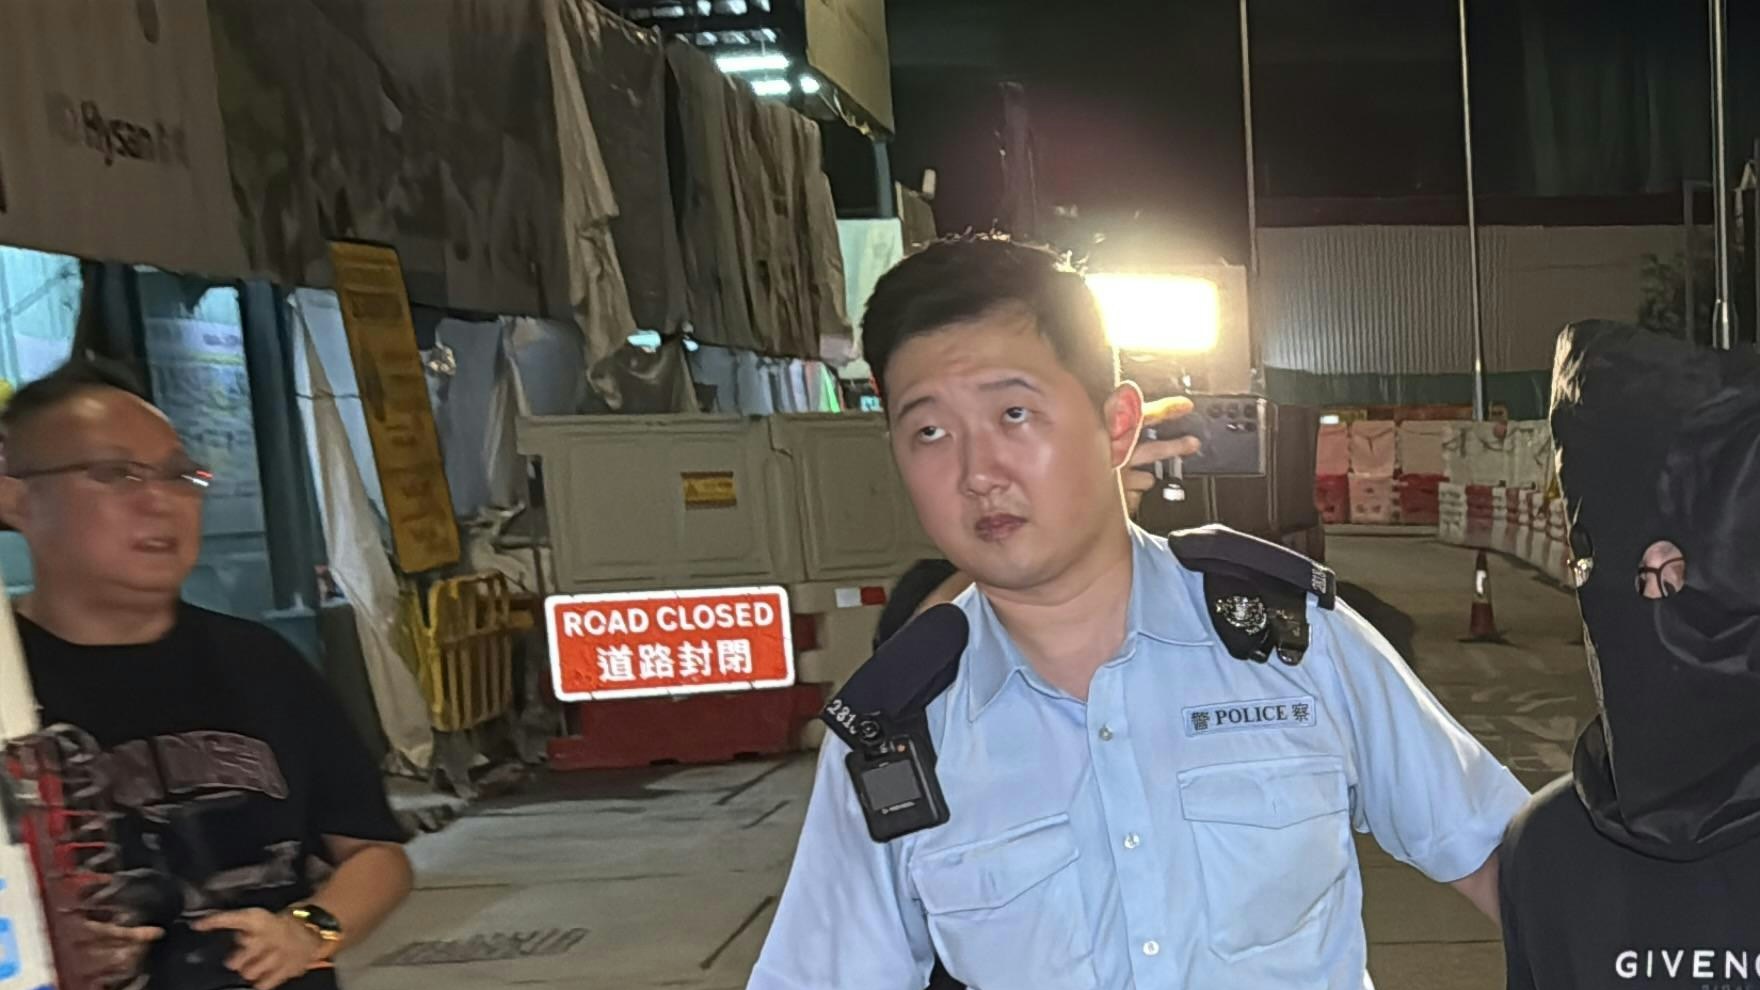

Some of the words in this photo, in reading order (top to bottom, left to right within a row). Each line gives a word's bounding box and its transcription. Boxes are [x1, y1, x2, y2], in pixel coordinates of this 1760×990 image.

[563, 608, 649, 637] ROAD
[656, 602, 774, 631] CLOSED
[596, 638, 753, 682] 道路封閉
[1215, 705, 1288, 725] POLICE
